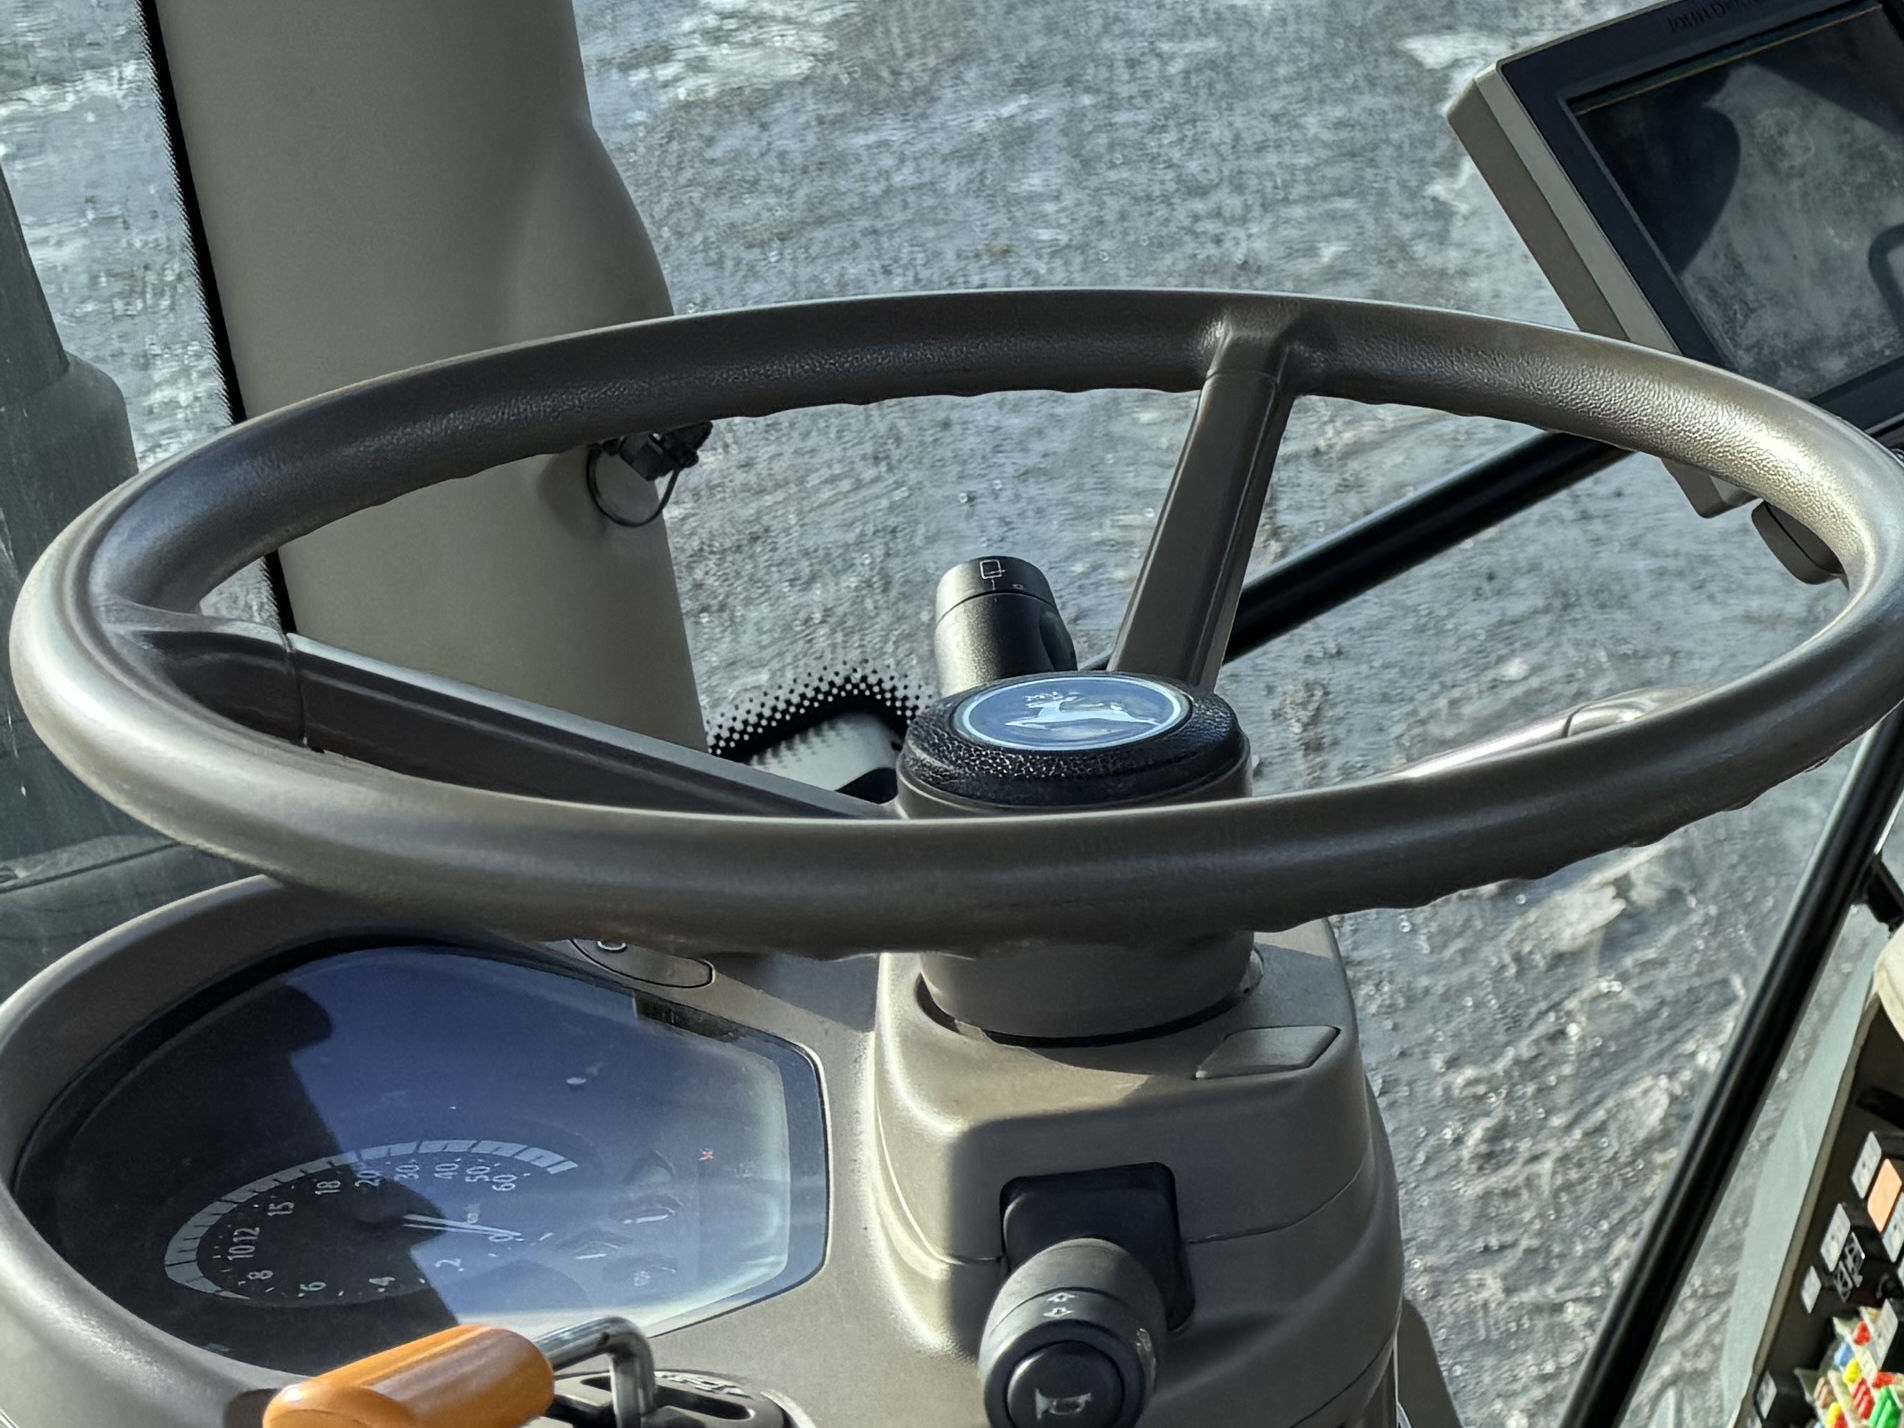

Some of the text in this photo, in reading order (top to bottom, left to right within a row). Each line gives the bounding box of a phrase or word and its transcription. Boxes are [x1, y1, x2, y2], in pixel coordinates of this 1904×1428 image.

[355, 1170, 380, 1188] 20
[394, 1164, 420, 1181] 30
[434, 1163, 460, 1180] 40
[465, 1166, 491, 1183] 50
[315, 1180, 342, 1196] 18
[492, 1174, 518, 1192] 60
[267, 1198, 295, 1217] 15
[232, 1226, 261, 1243] 12
[227, 1244, 256, 1261] 10
[247, 1270, 274, 1281] 8
[300, 1281, 327, 1292] 6
